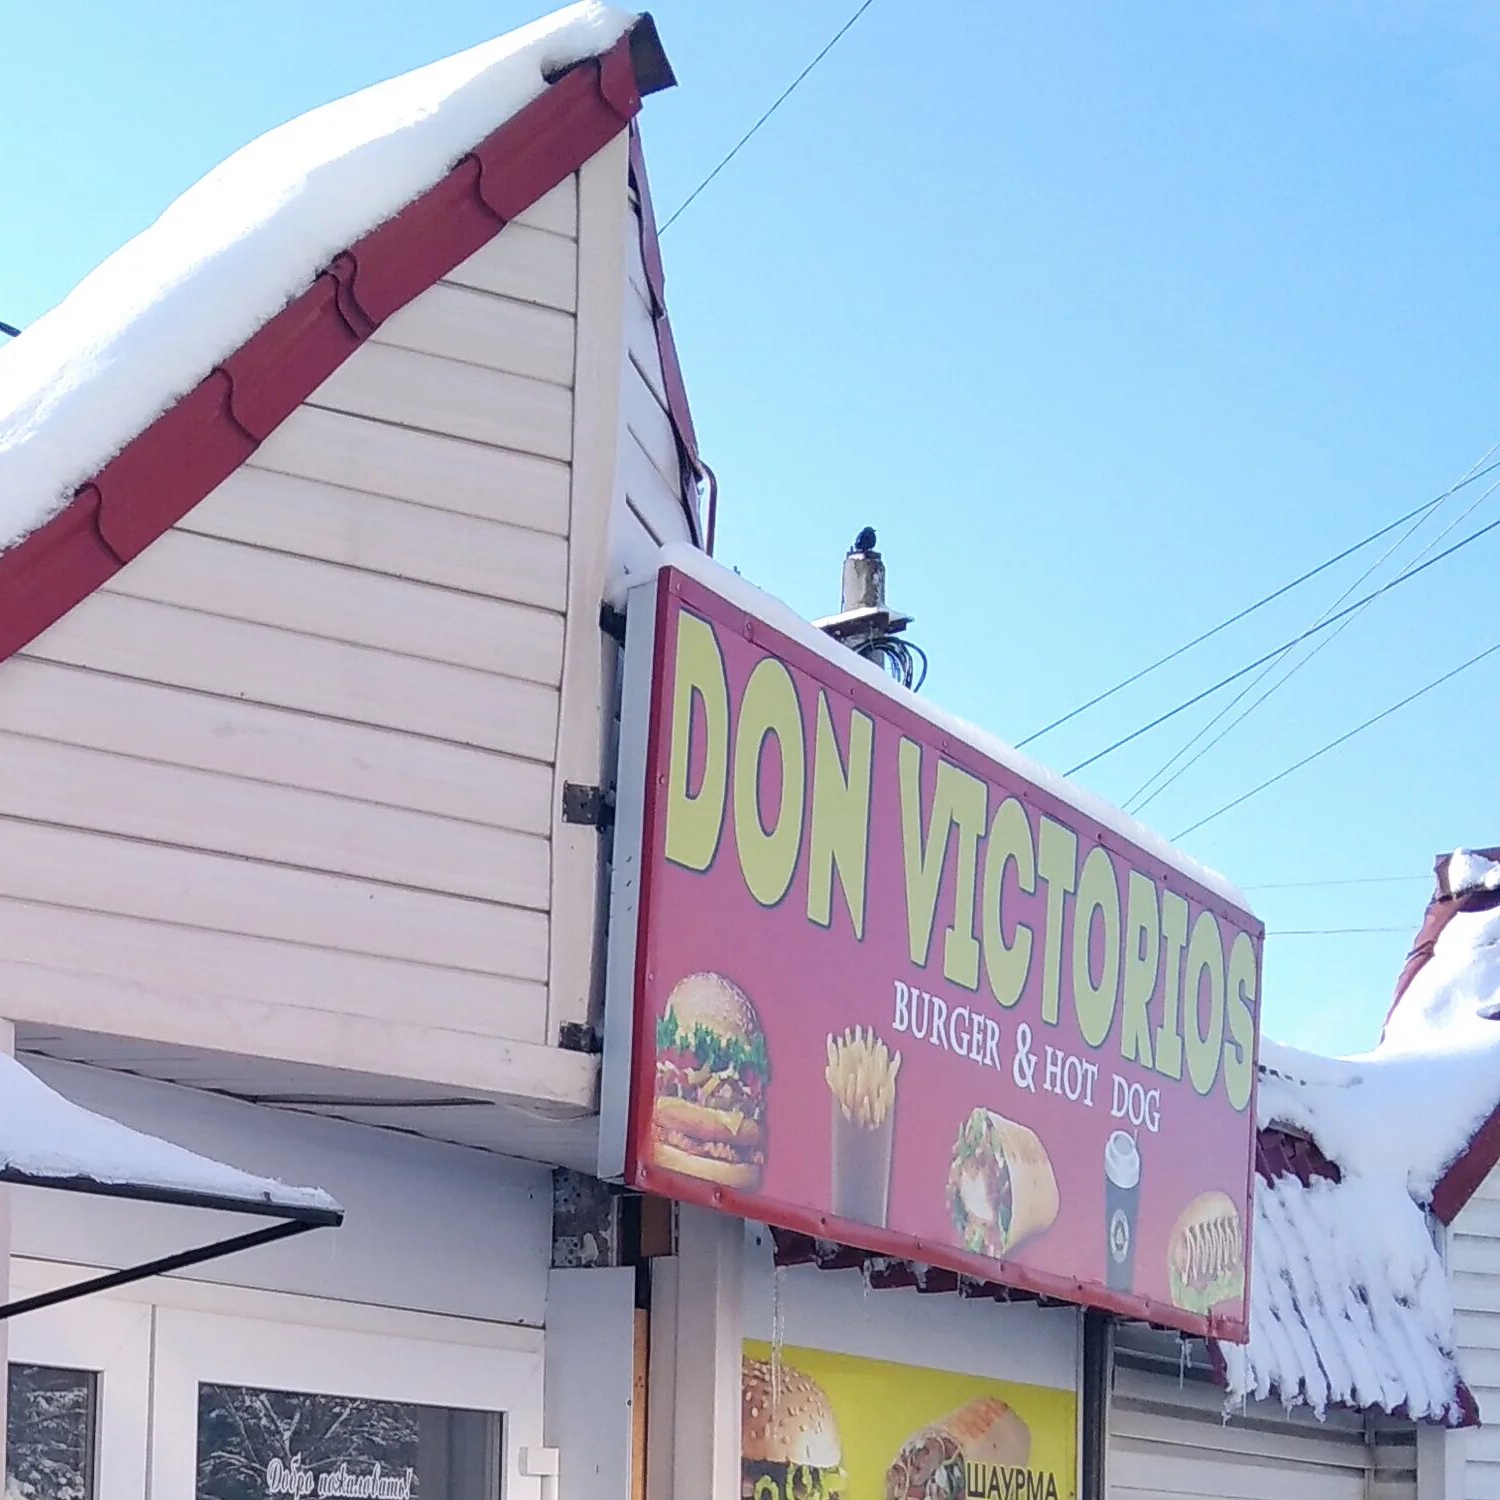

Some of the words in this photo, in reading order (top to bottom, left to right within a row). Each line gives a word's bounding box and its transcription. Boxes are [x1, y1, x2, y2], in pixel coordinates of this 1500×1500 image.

[664, 610, 874, 940] DON
[900, 736, 1256, 1111] VICTORIOS
[892, 980, 1000, 1068] BURGER
[1012, 1024, 1037, 1093] &
[1044, 1047, 1098, 1103] HOT
[1111, 1072, 1161, 1133] DOG
